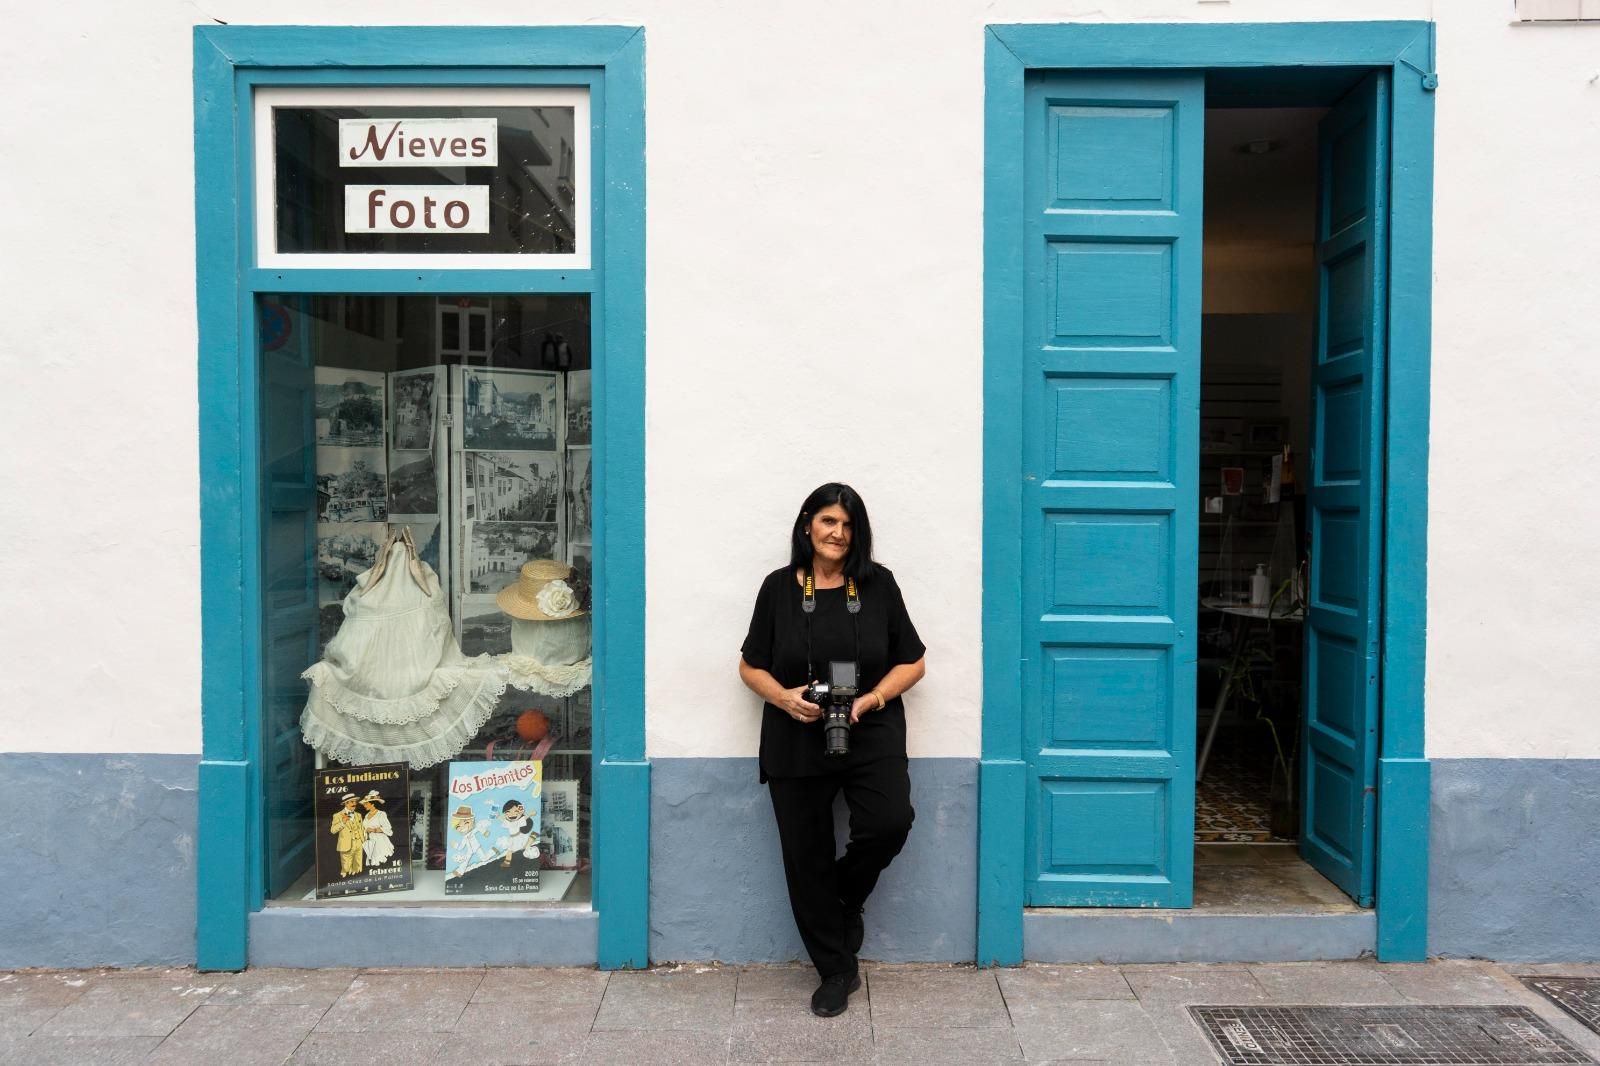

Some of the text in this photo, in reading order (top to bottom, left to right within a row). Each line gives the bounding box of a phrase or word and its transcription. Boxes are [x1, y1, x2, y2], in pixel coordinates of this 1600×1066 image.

[350, 121, 487, 161] Nieves
[368, 189, 470, 229] foto
[805, 576, 813, 596] Nikon
[325, 771, 400, 785] Los Indianos
[325, 786, 349, 795] 2026
[452, 779, 473, 793] Los
[369, 867, 403, 876] febrero
